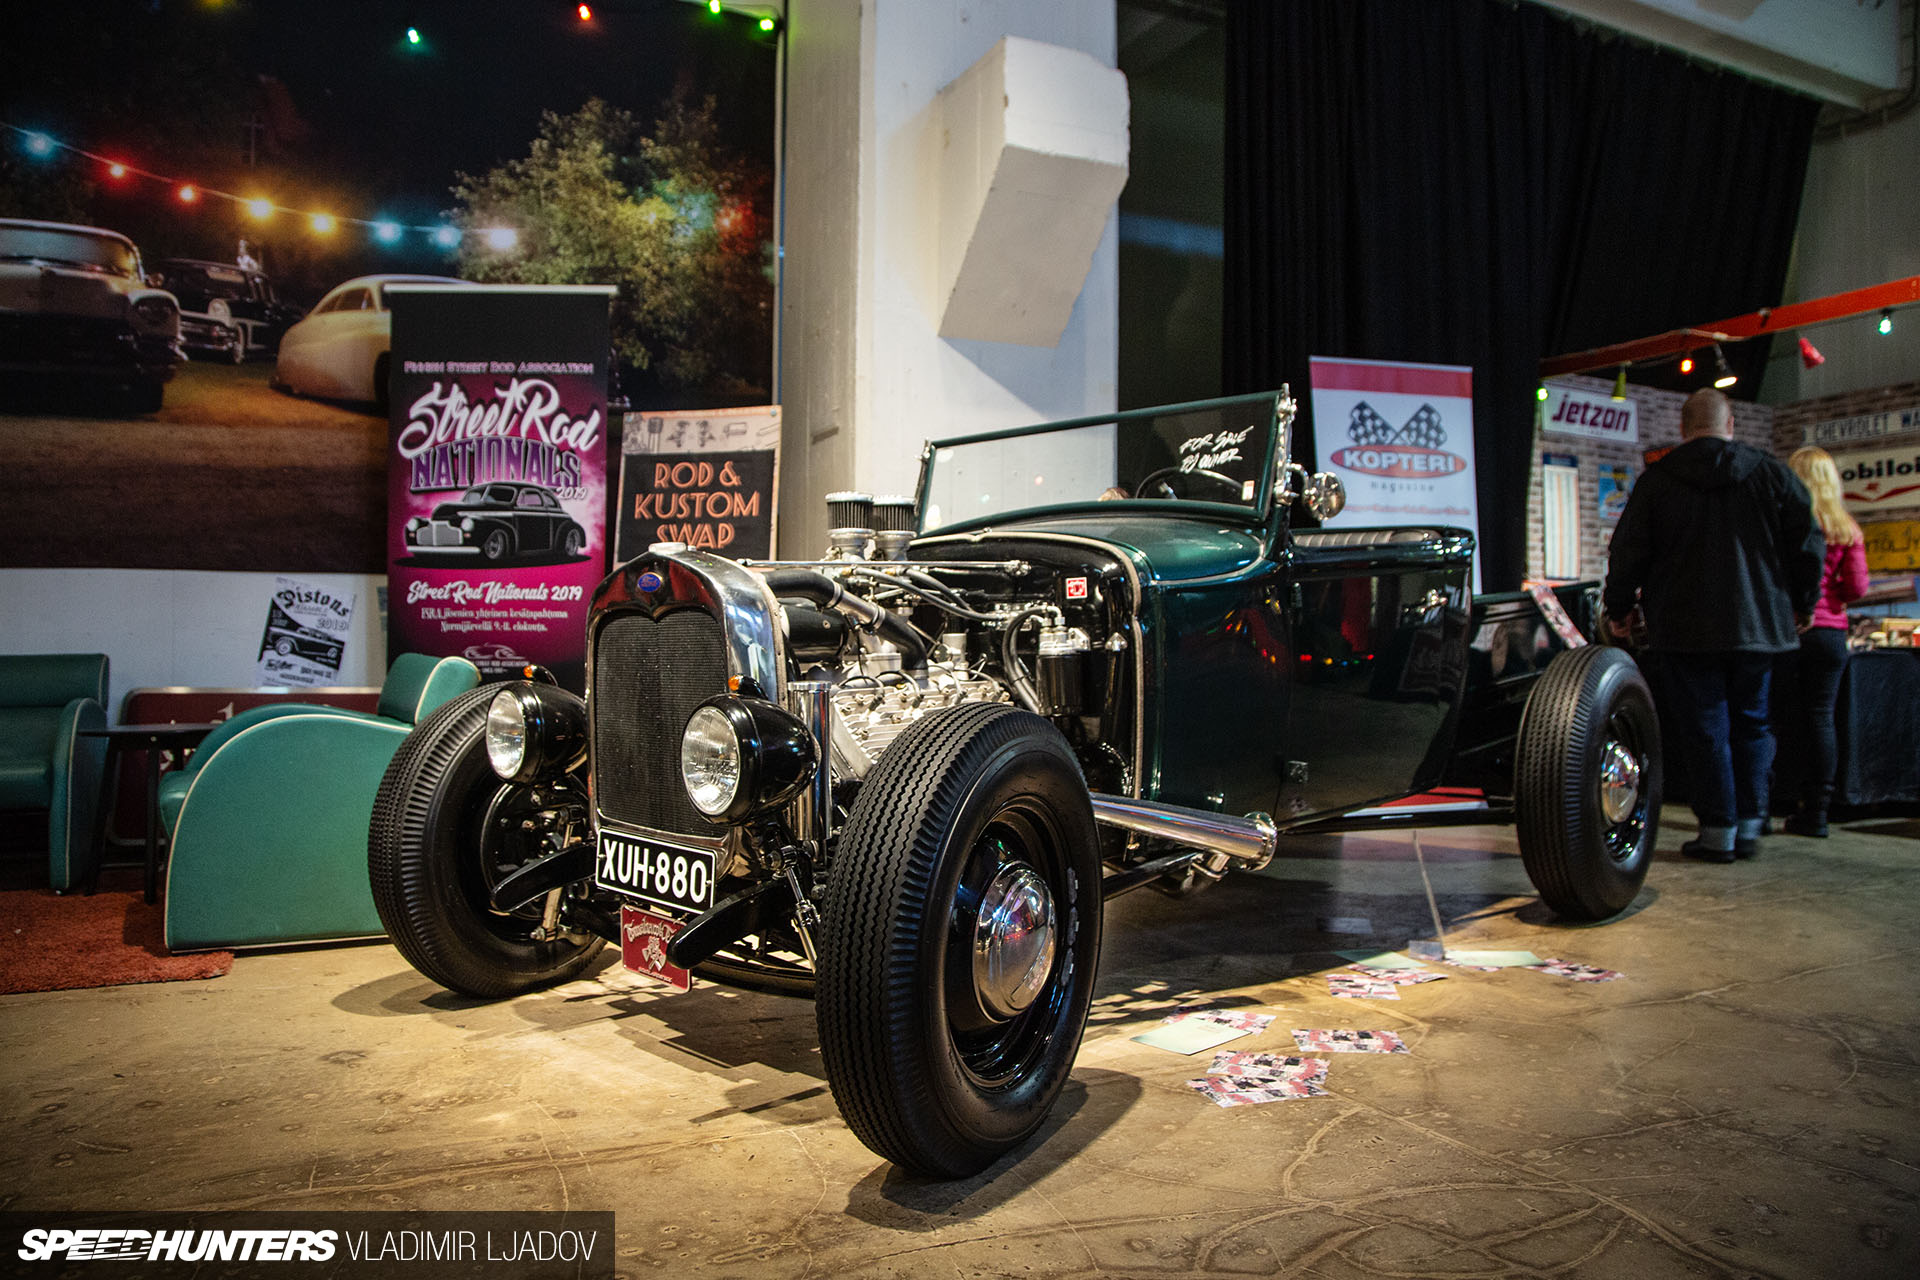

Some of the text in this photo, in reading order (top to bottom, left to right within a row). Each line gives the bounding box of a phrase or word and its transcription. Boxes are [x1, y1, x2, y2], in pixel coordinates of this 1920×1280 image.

[398, 377, 601, 459] Street Rod
[1552, 393, 1630, 432] jetzon
[1180, 433, 1213, 454] FOR
[410, 436, 581, 492] NATIONALS
[1198, 448, 1243, 469] OWNER
[1343, 449, 1456, 473] KOPTERI
[654, 461, 742, 488] ROD &
[556, 487, 588, 500] 2019
[634, 490, 760, 519] KUSTOM
[656, 522, 736, 549] SWAP
[407, 580, 583, 604] Street Rod Nationals 2019
[601, 838, 707, 903] XUH-880
